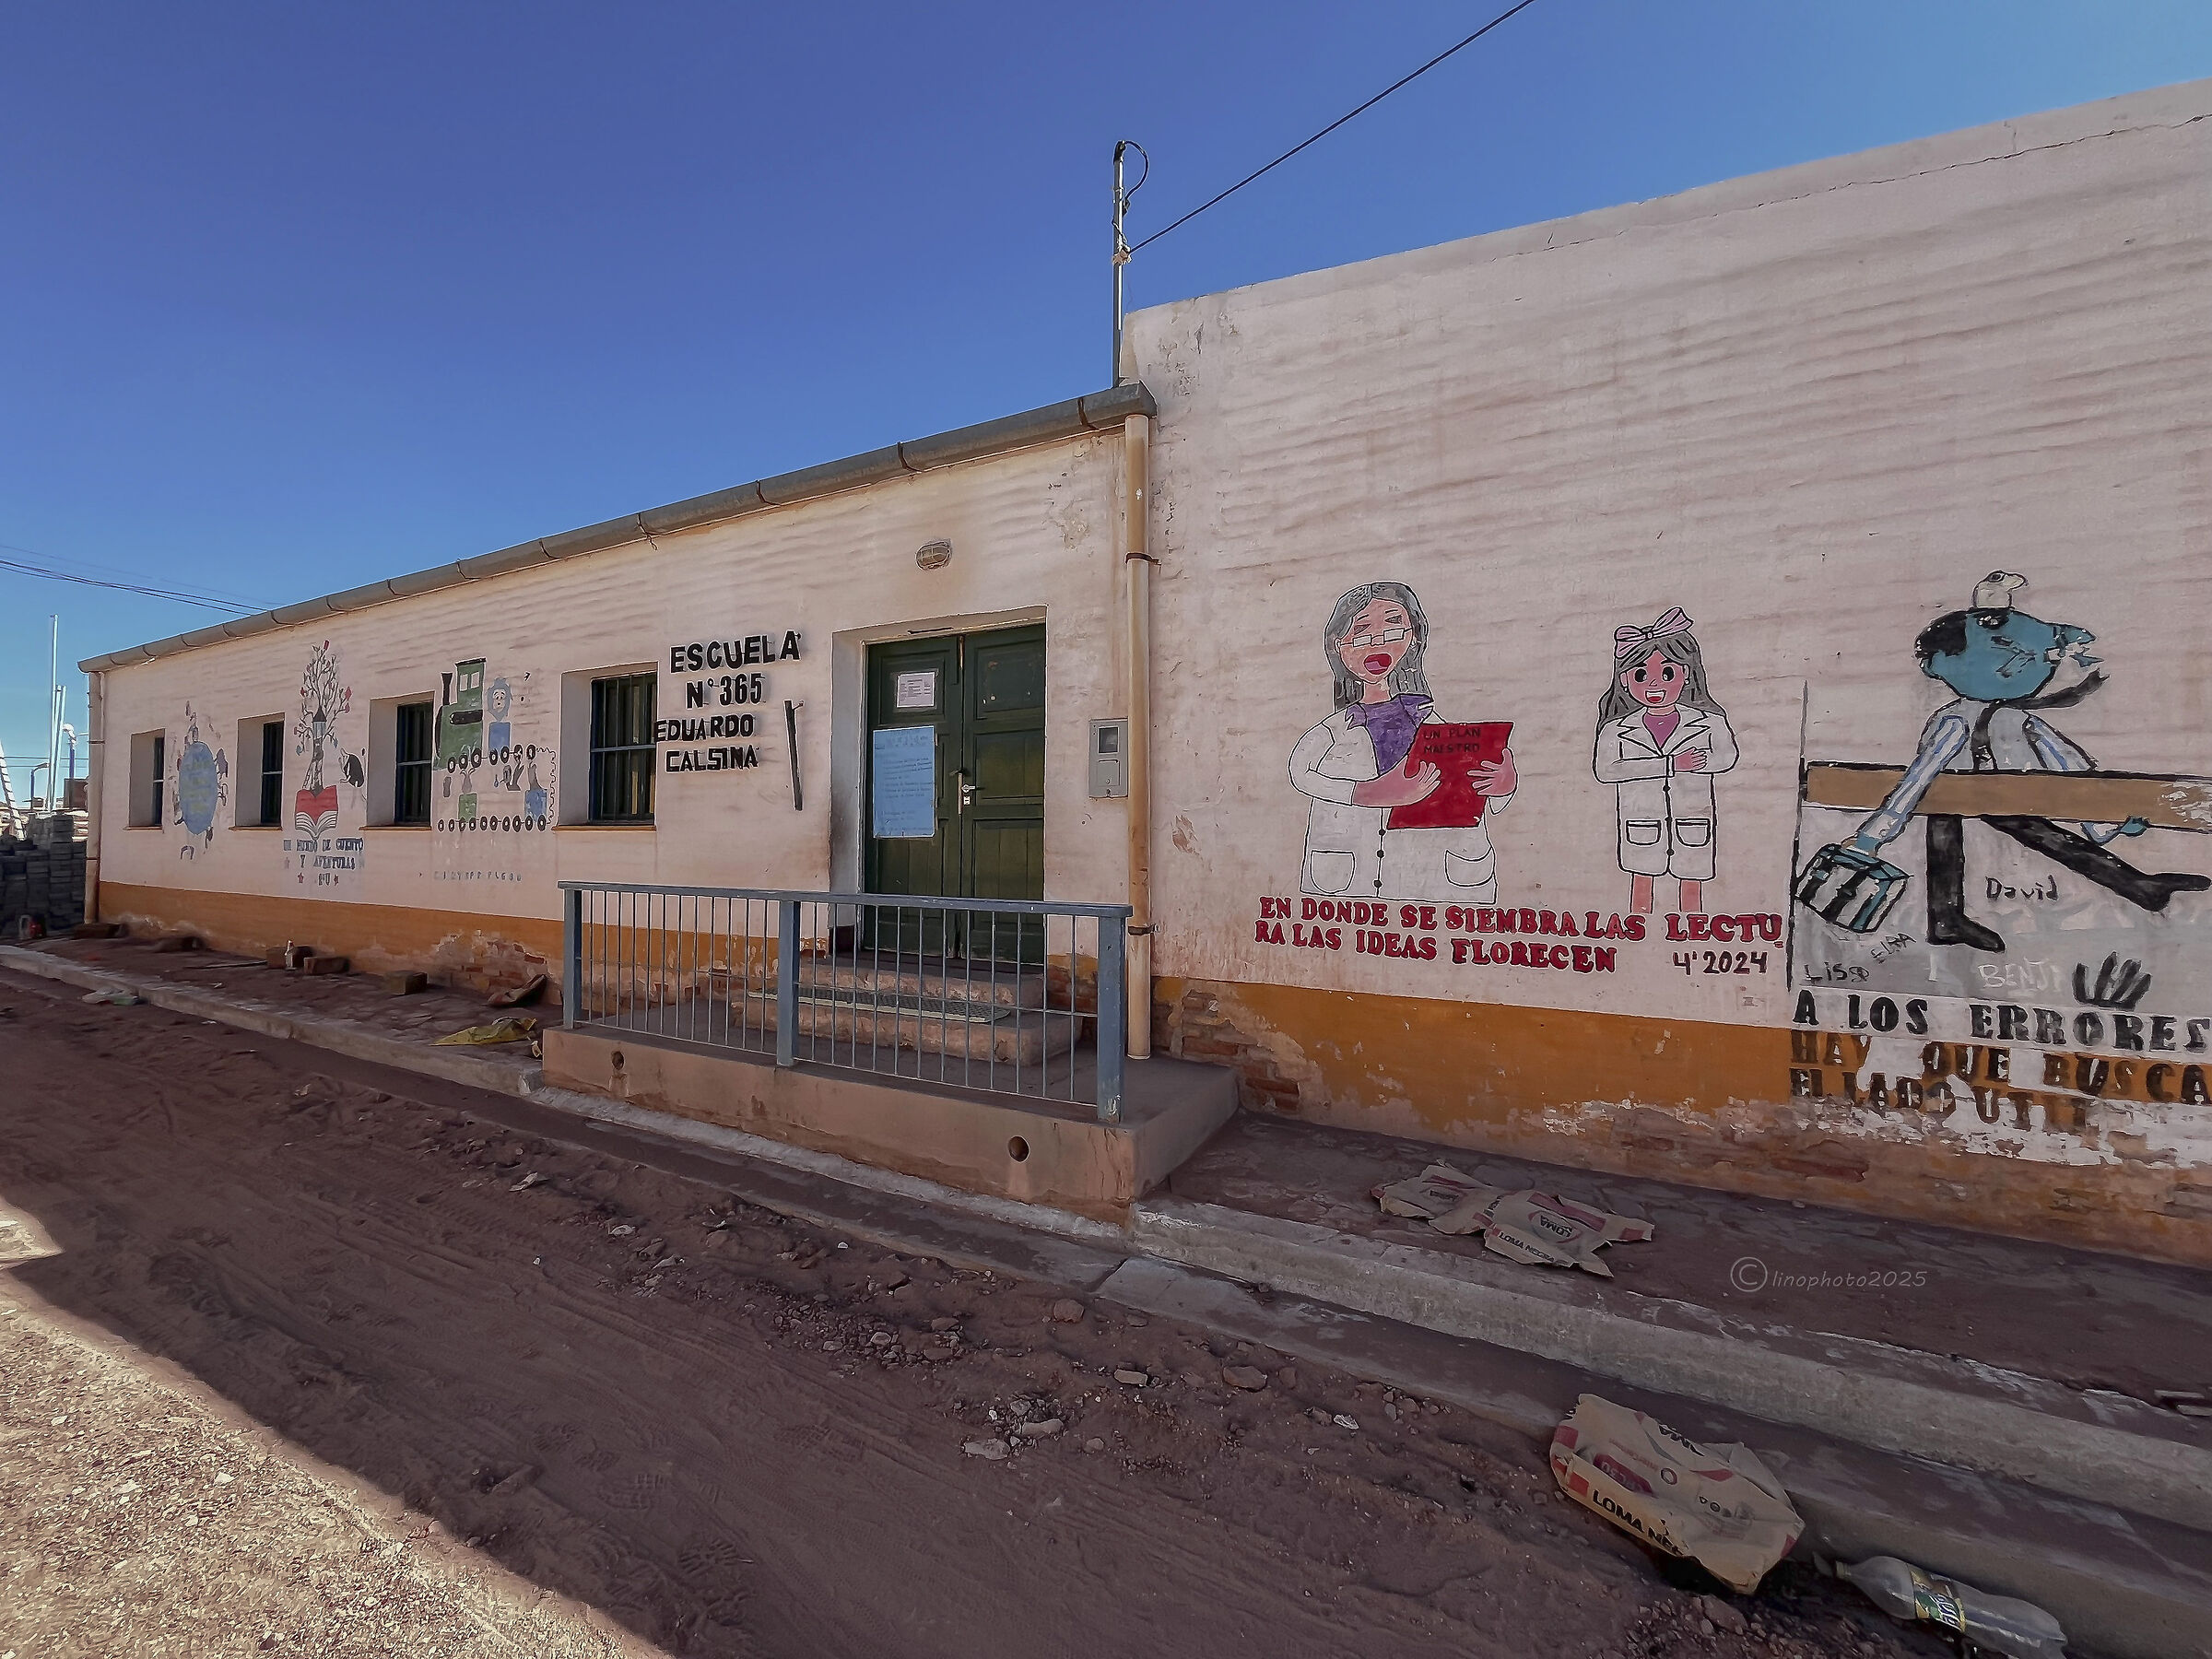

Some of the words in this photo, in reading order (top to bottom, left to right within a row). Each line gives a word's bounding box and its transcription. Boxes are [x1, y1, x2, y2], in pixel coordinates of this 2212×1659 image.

[670, 629, 801, 673] ESCUELA
[654, 713, 755, 742] EDUARDO
[665, 745, 759, 772] CALSINA
[1984, 875, 2059, 901] David
[1259, 896, 1292, 920] EN
[1300, 897, 1389, 927] DONDE
[1400, 903, 1438, 931] SE
[1444, 905, 1580, 938] SIEMBRA
[1583, 911, 1646, 941] LAS
[1254, 920, 1287, 946] RA
[1292, 924, 1343, 951] LAS
[1355, 929, 1438, 961] IDEAS
[1451, 937, 1618, 973] FLORECEN
[1792, 989, 1818, 1027] A
[1848, 994, 1929, 1035] LOS
[1969, 1003, 2211, 1054] ERRORES
[1593, 1488, 1645, 1534] LOMA
